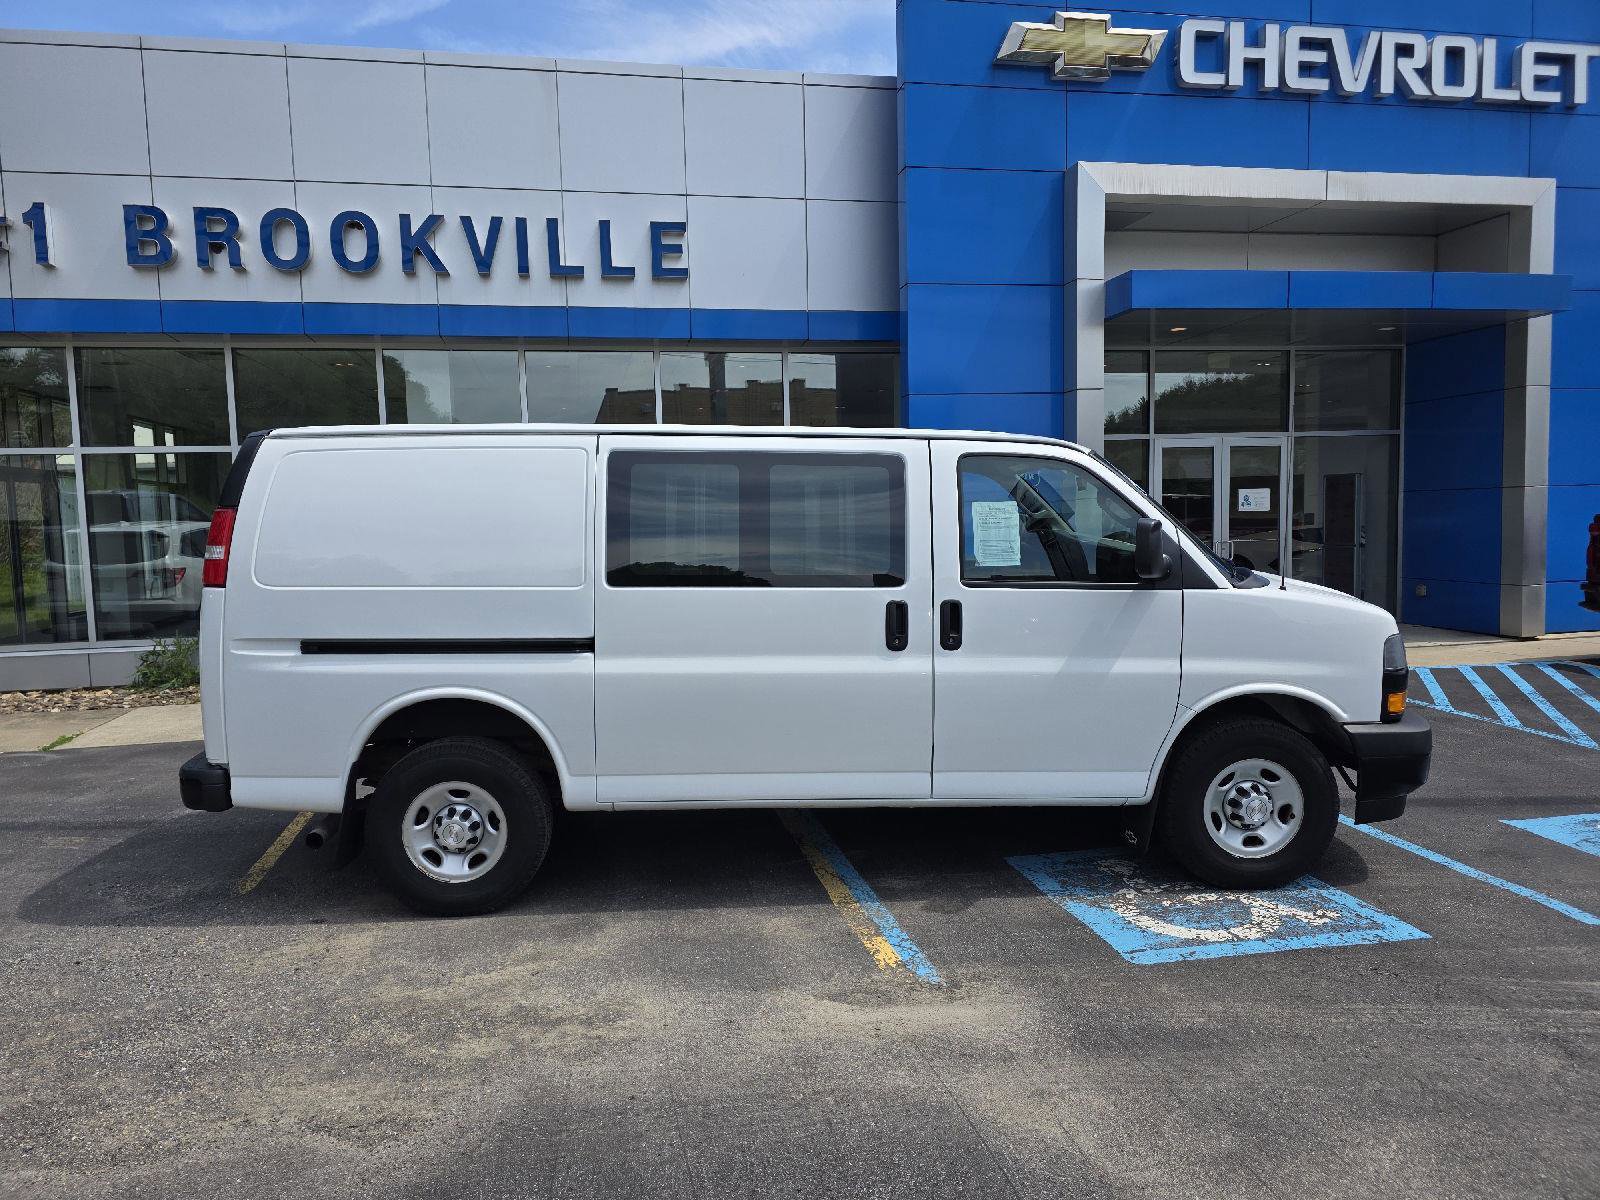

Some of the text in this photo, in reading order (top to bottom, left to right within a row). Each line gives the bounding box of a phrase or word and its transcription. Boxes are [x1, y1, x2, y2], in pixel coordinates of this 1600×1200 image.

[1177, 18, 1600, 106] CHEVROLET
[0, 201, 688, 280] 1 BROOKVILLE
